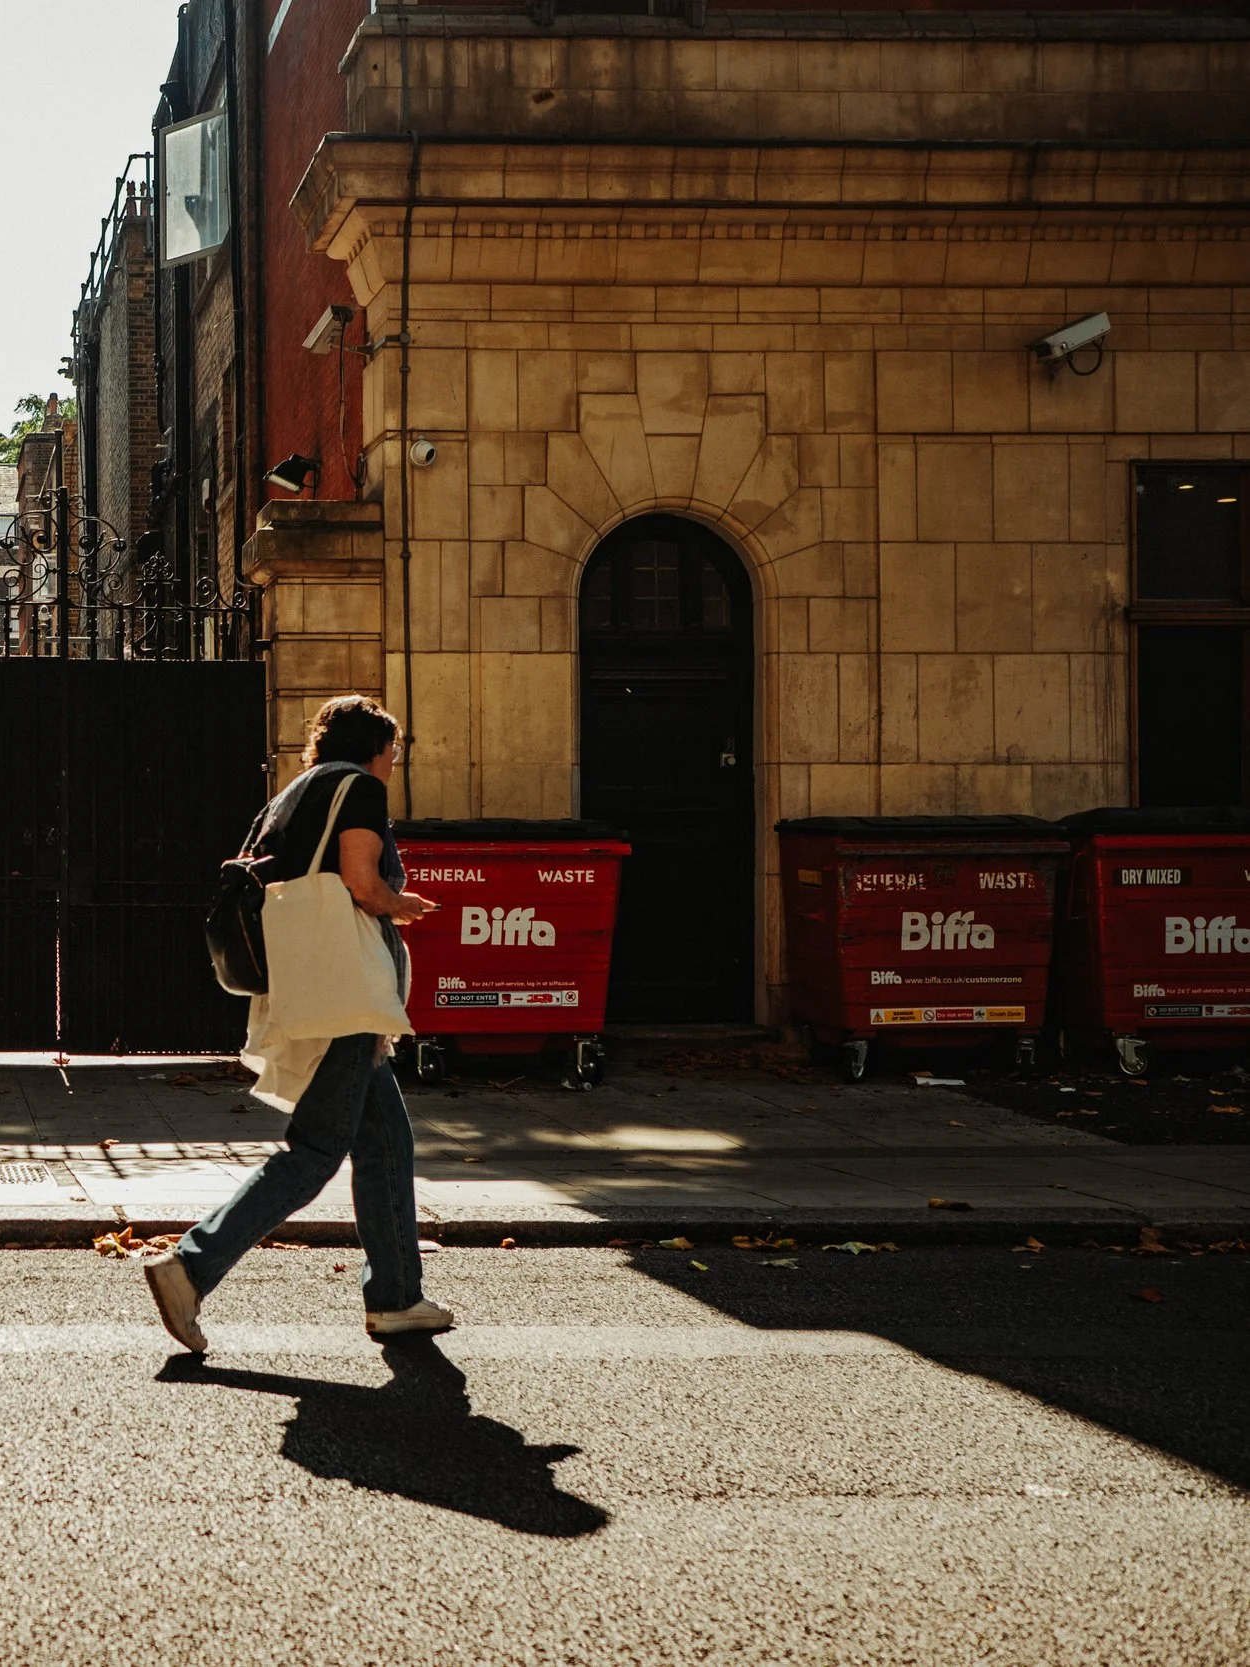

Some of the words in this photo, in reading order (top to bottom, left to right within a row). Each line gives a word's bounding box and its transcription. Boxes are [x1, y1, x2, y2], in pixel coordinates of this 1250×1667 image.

[538, 869, 595, 883] WASTE
[1121, 869, 1143, 885] DRY
[1146, 869, 1181, 885] MIXED
[460, 906, 556, 947] Biffa
[901, 910, 995, 951] Biffa
[1165, 915, 1250, 954] Biffa
[438, 976, 467, 989] Biffa
[871, 970, 902, 985] Biffa
[904, 975, 1023, 985] www.biffa.co.uk/customerzone
[1133, 984, 1166, 998] Biffa
